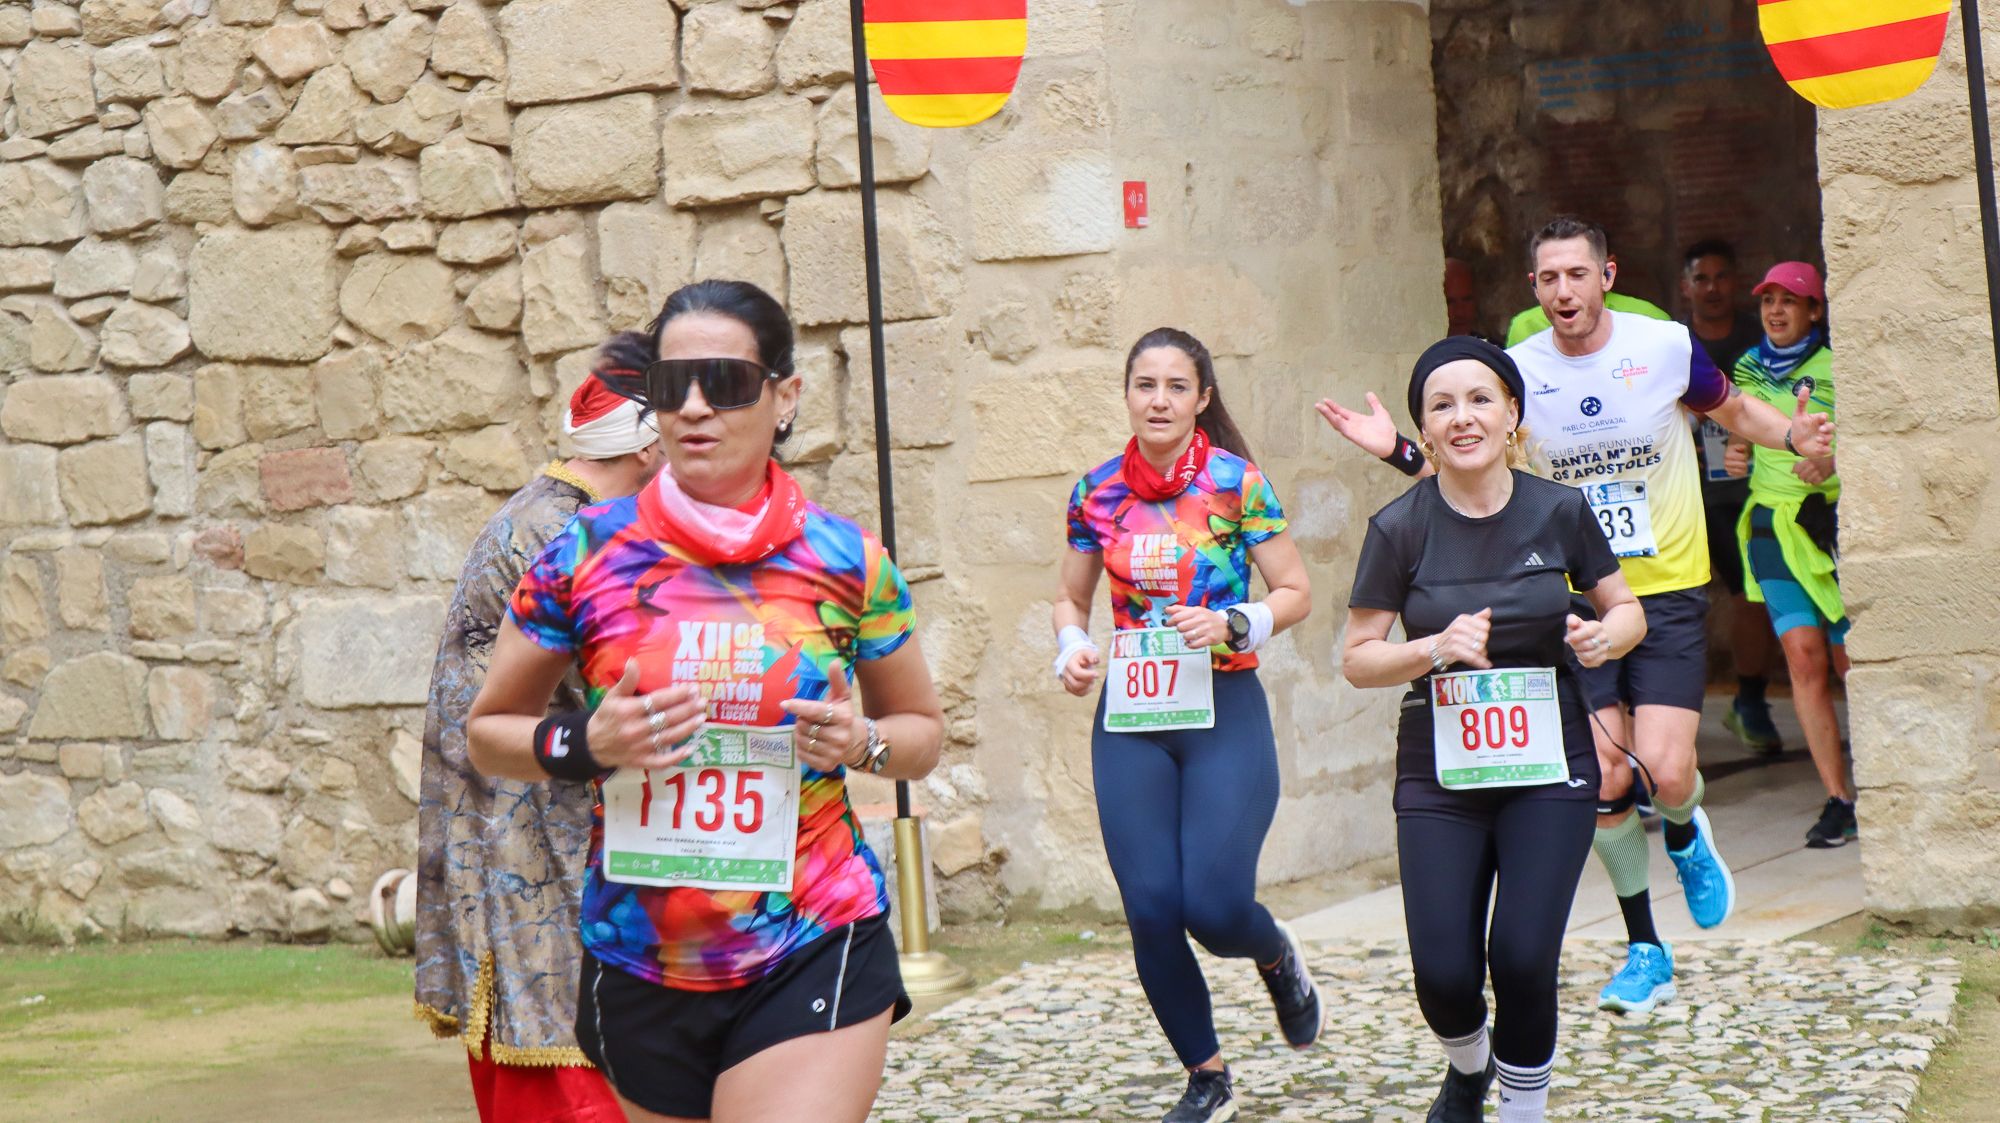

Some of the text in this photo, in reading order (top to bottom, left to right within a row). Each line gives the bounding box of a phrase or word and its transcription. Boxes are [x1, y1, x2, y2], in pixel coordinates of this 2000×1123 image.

[1562, 422, 1586, 433] PABLO
[1589, 416, 1627, 429] CARVAJAL
[1547, 435, 1654, 459] CLUB DE RUNNING
[1551, 452, 1602, 468] SANTA
[1631, 444, 1653, 457] DE
[1574, 452, 1661, 479] APÓSTOLES
[1132, 534, 1161, 556] XII
[1131, 557, 1160, 568] MEDIA
[1131, 565, 1178, 580] MARATÓN
[677, 621, 731, 660] XII
[733, 623, 765, 648] 08
[672, 661, 732, 681] MEDIA
[1127, 659, 1180, 699] 807
[1442, 676, 1480, 705] 10K
[1460, 705, 1530, 751] 809
